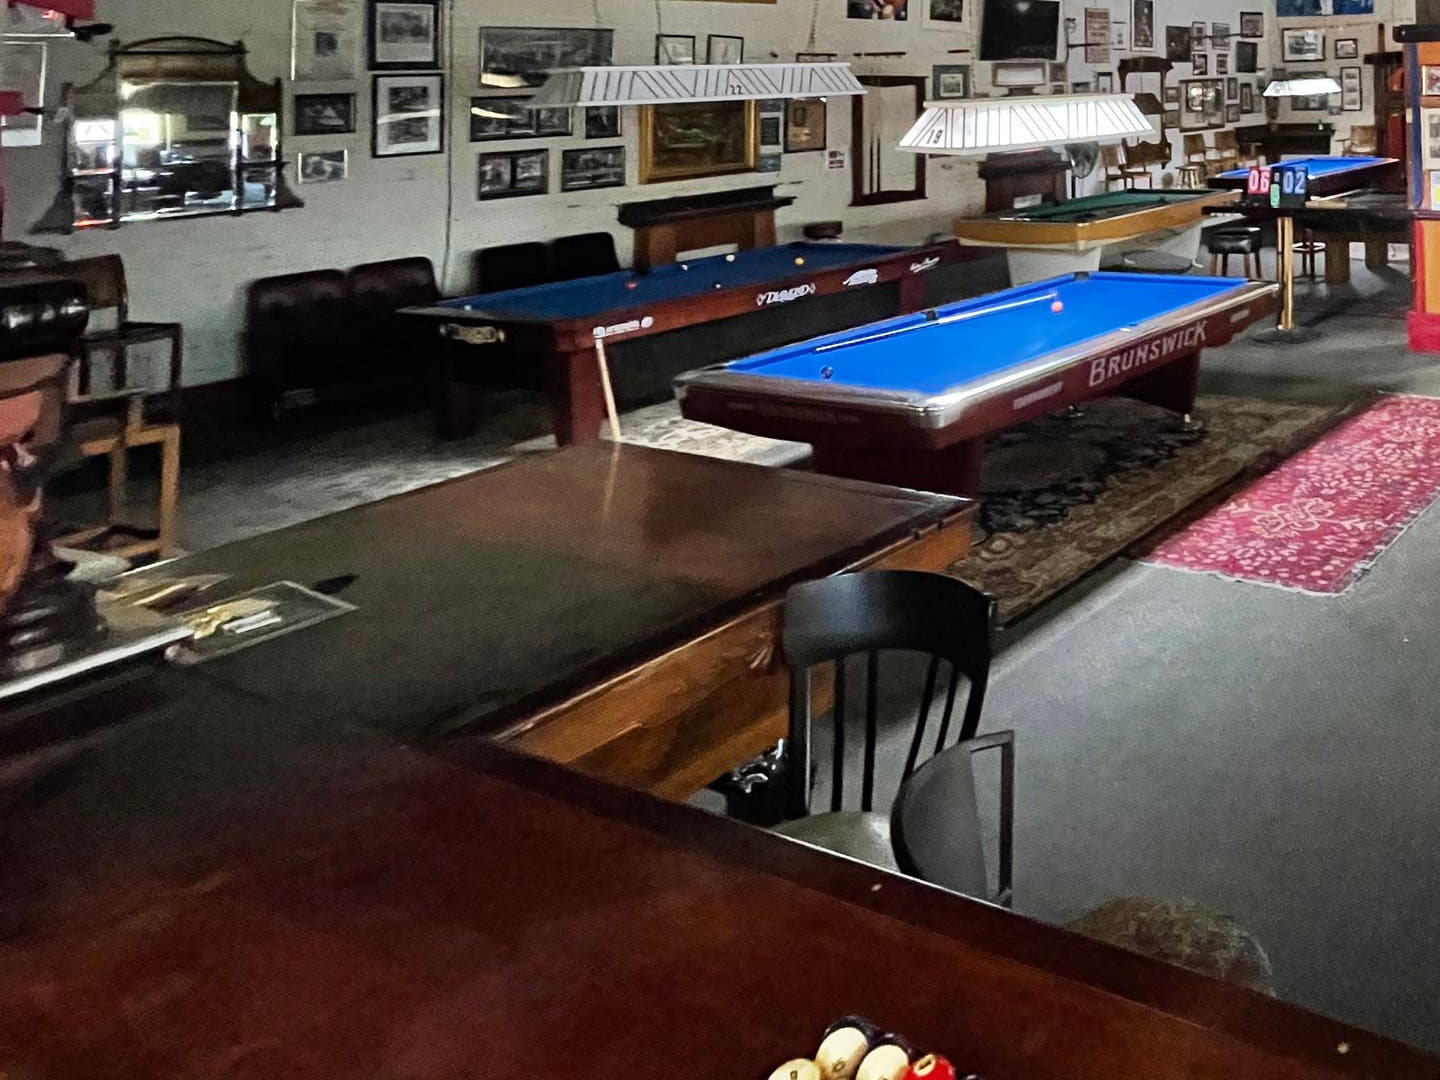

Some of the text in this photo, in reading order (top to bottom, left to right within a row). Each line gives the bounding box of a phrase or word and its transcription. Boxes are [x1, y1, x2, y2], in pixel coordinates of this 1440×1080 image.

[729, 84, 744, 95] 22
[925, 129, 943, 145] 19
[1248, 169, 1306, 194] 06 02
[1088, 319, 1208, 388] BRUNSWICK
